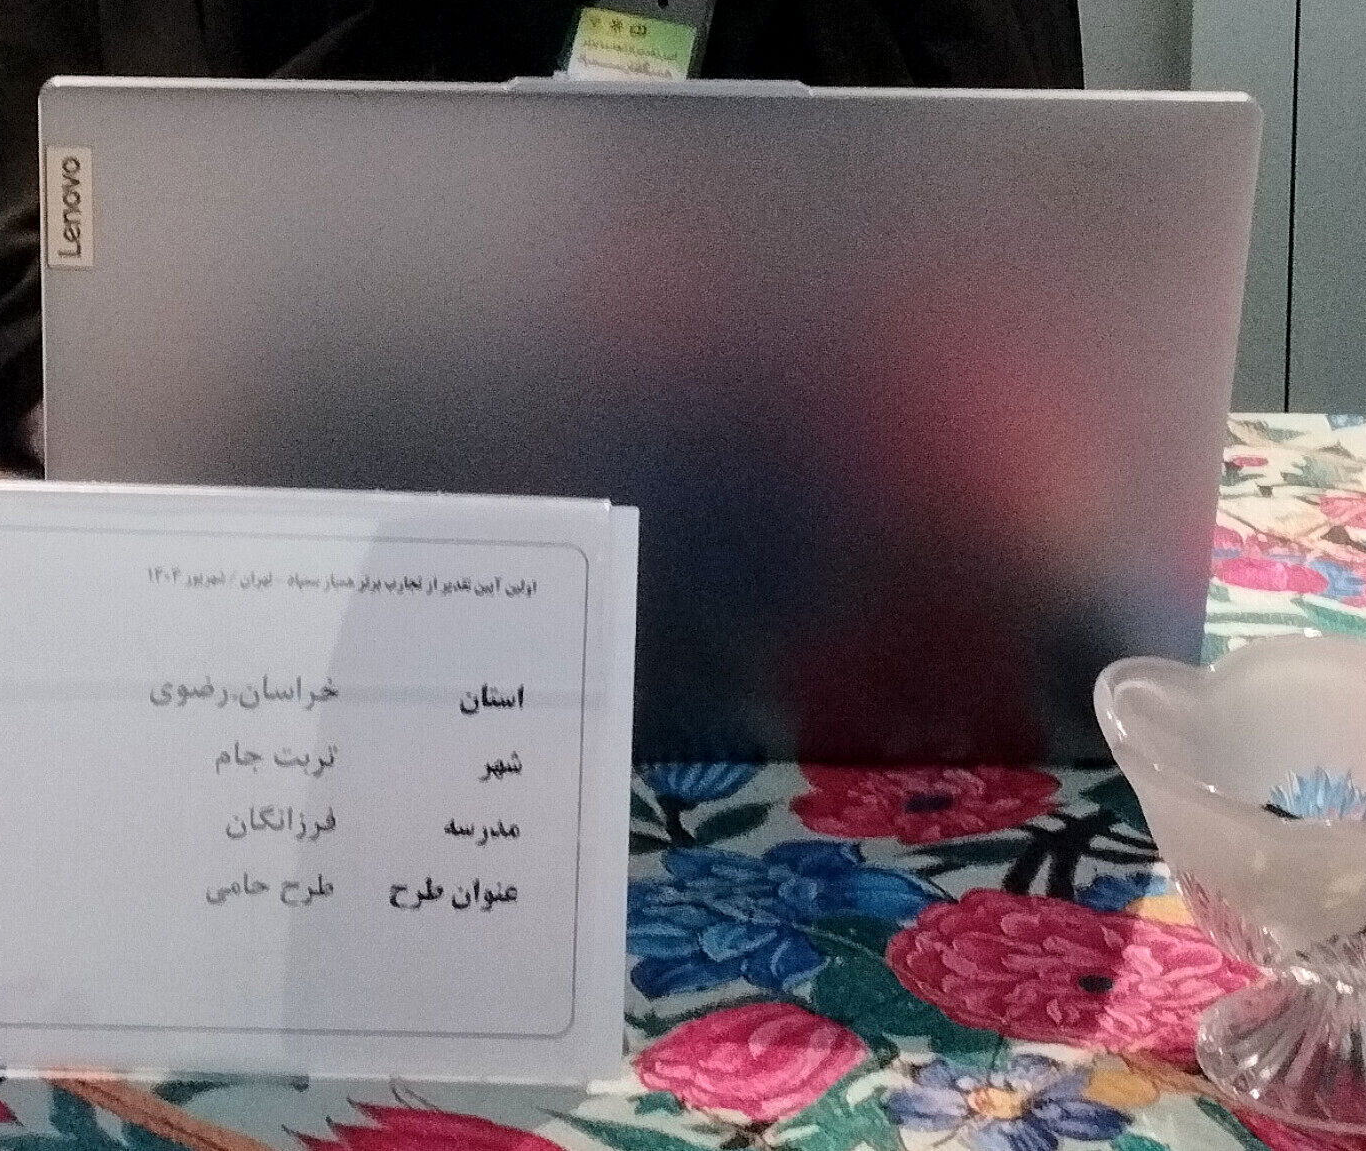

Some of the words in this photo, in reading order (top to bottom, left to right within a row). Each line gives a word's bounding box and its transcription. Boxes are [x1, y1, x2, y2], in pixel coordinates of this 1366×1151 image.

[57, 156, 82, 258] Lenovo
[150, 675, 229, 708] رضوی
[239, 674, 339, 711] خراسان
[460, 682, 524, 715] استان
[216, 740, 262, 775] جام
[274, 743, 338, 778] تربت
[478, 751, 522, 783] شهر
[226, 805, 335, 840] فرزانگان
[444, 818, 520, 846] مدرسه
[206, 871, 269, 905] حامی
[281, 873, 333, 907] طرح
[389, 876, 443, 909] طرح
[452, 877, 517, 912] عنوان
